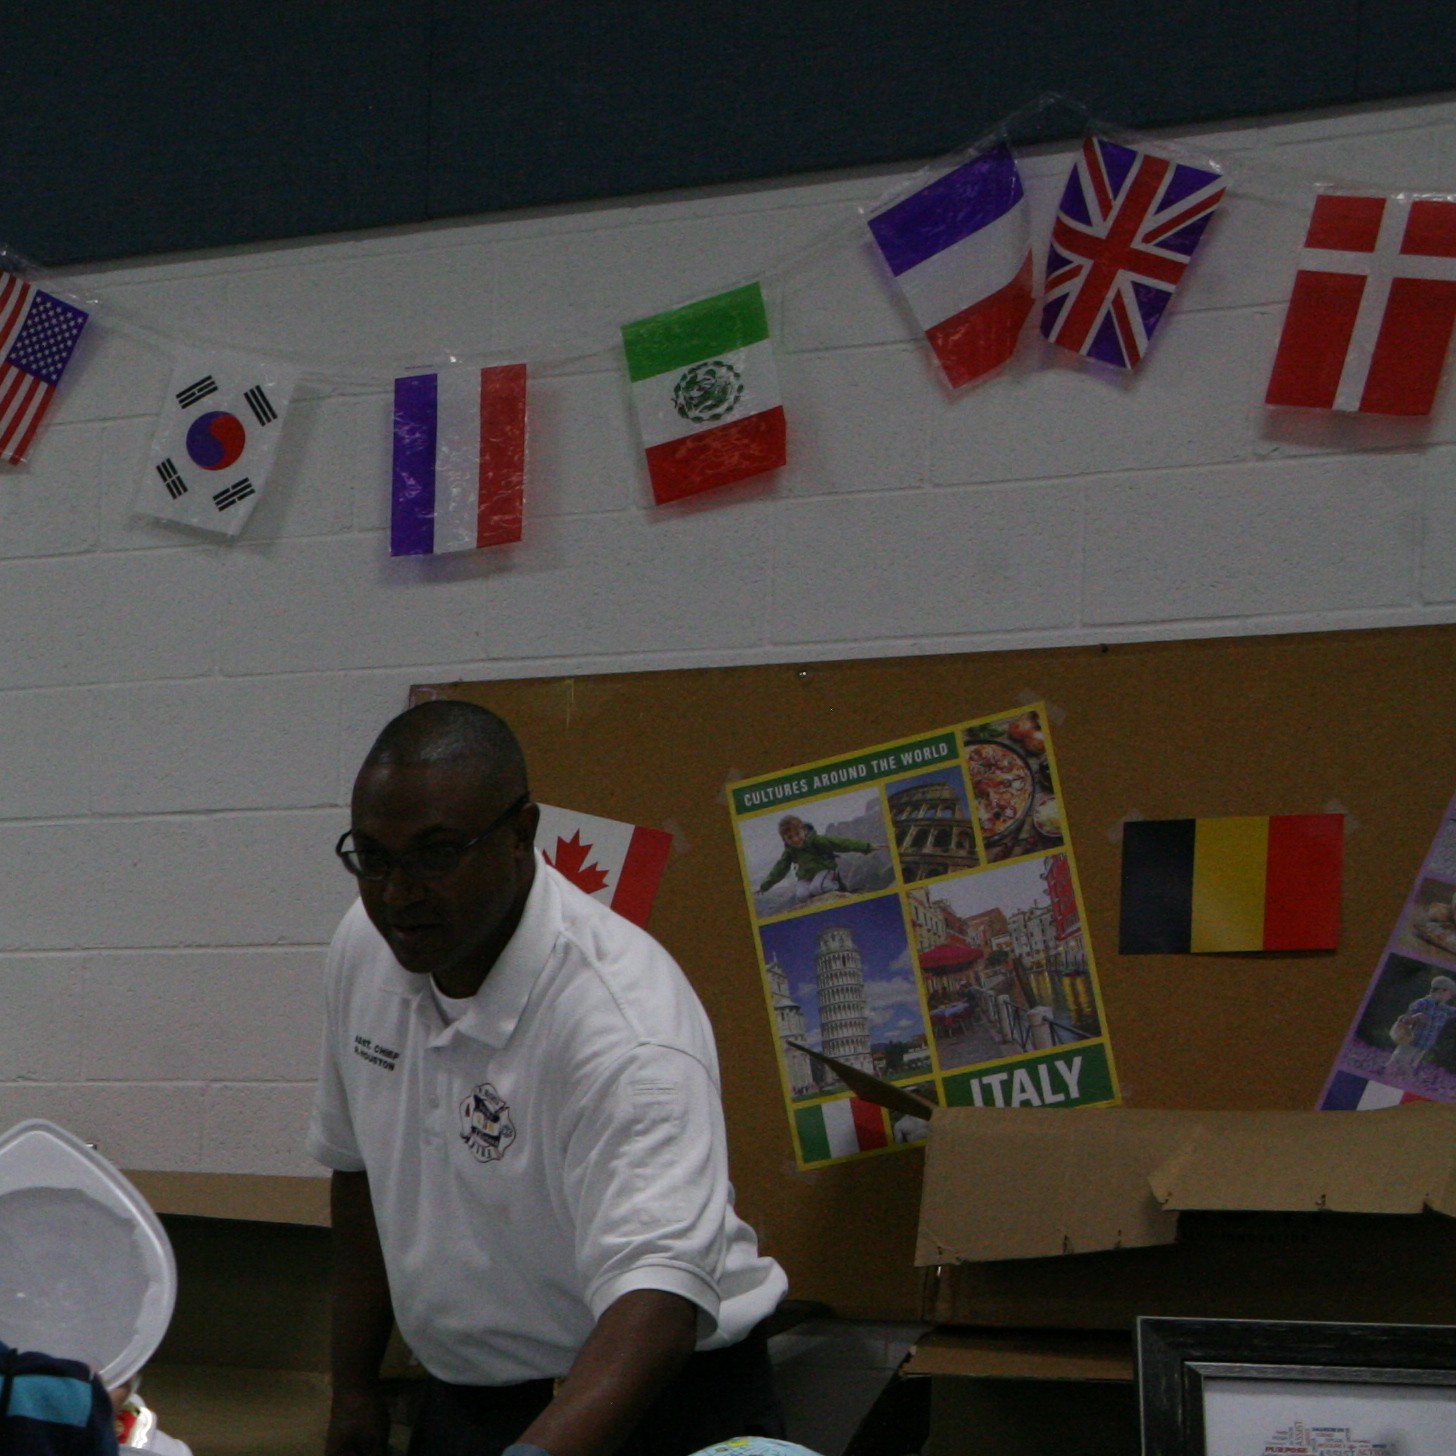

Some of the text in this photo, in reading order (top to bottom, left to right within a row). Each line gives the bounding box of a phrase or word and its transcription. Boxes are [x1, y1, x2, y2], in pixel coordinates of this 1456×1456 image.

[743, 742, 949, 807] CULTURES AROUND THE WORLD
[969, 1055, 1083, 1109] ITALY
